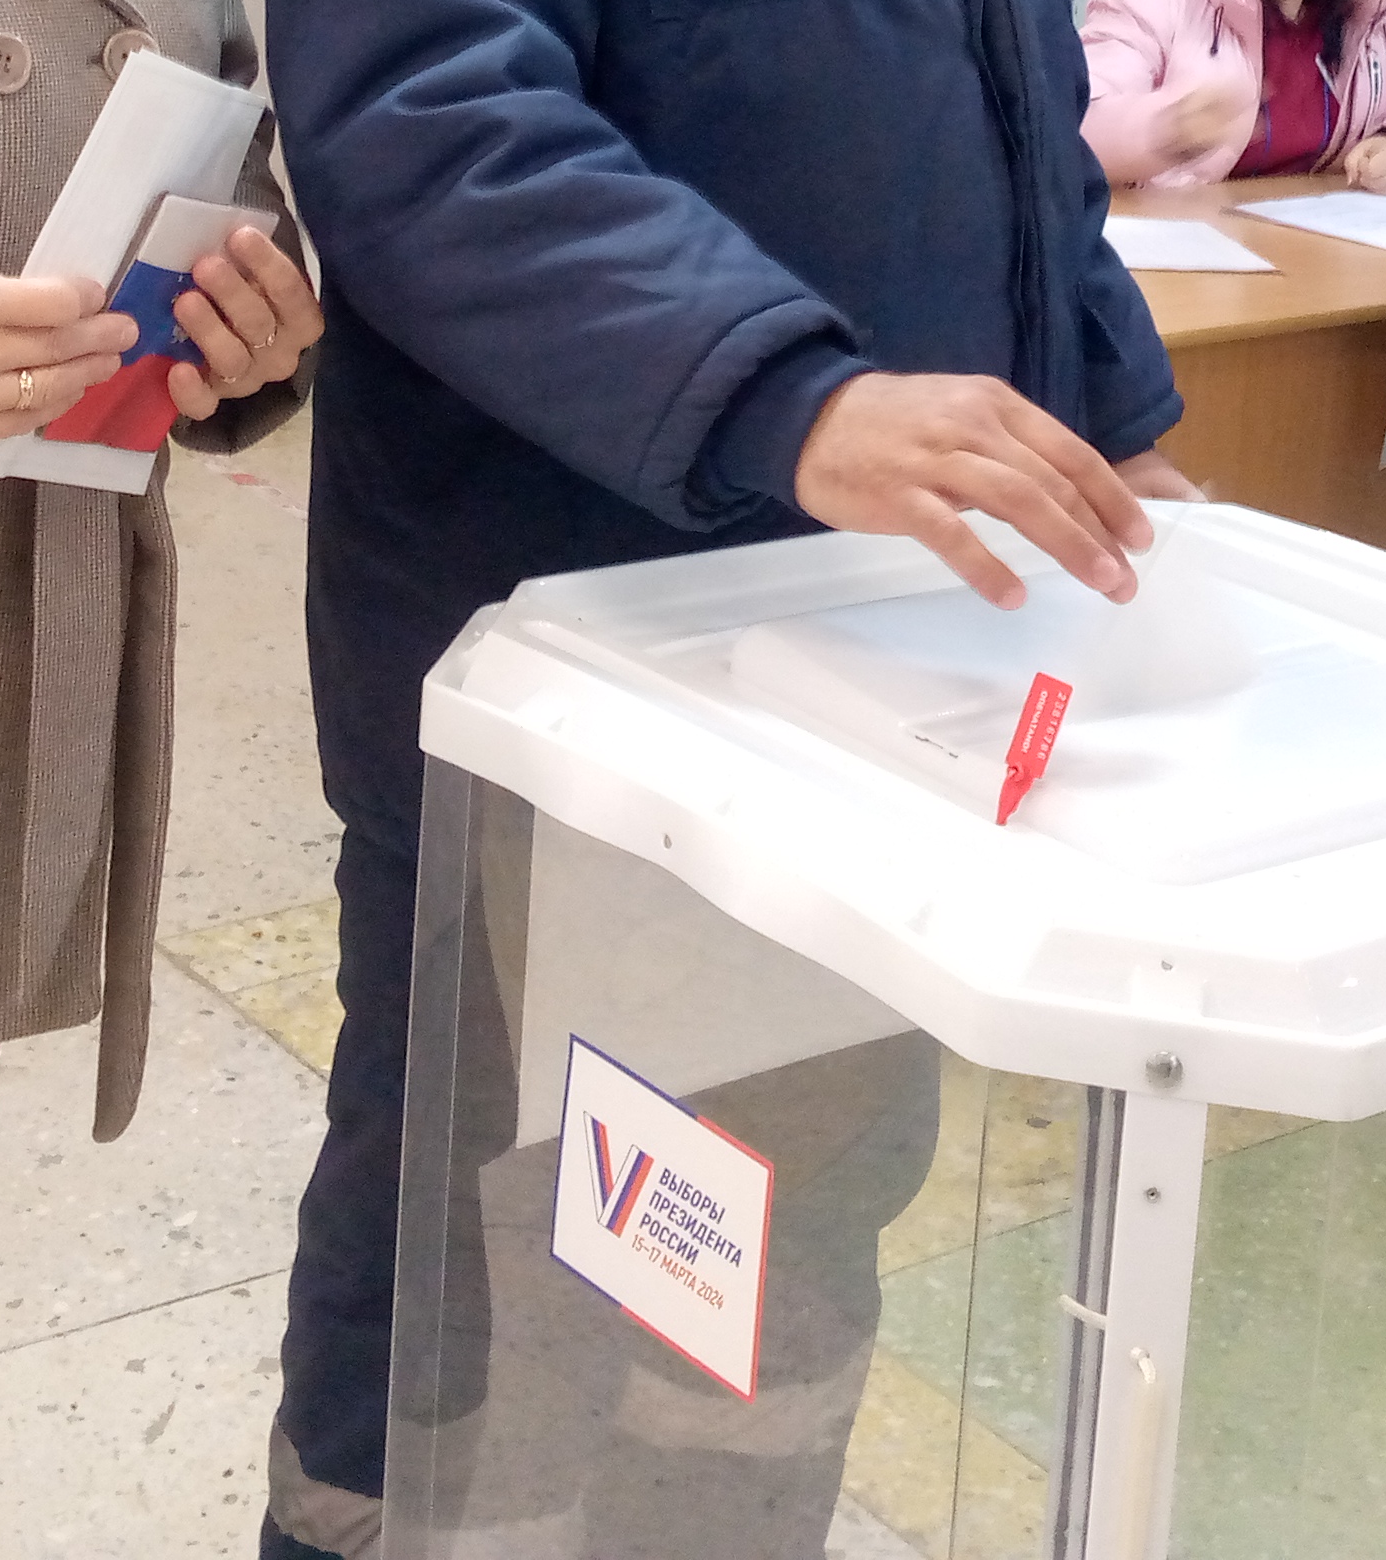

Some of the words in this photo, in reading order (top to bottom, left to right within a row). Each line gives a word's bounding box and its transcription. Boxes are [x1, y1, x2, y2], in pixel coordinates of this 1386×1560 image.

[659, 1167, 726, 1225] ВЫБОРЫ
[639, 1212, 700, 1266] РОССИИ
[648, 1190, 743, 1269] ПРЕЗИДЕНТА
[660, 1254, 697, 1291] МАРТА
[696, 1281, 724, 1310] 2024
